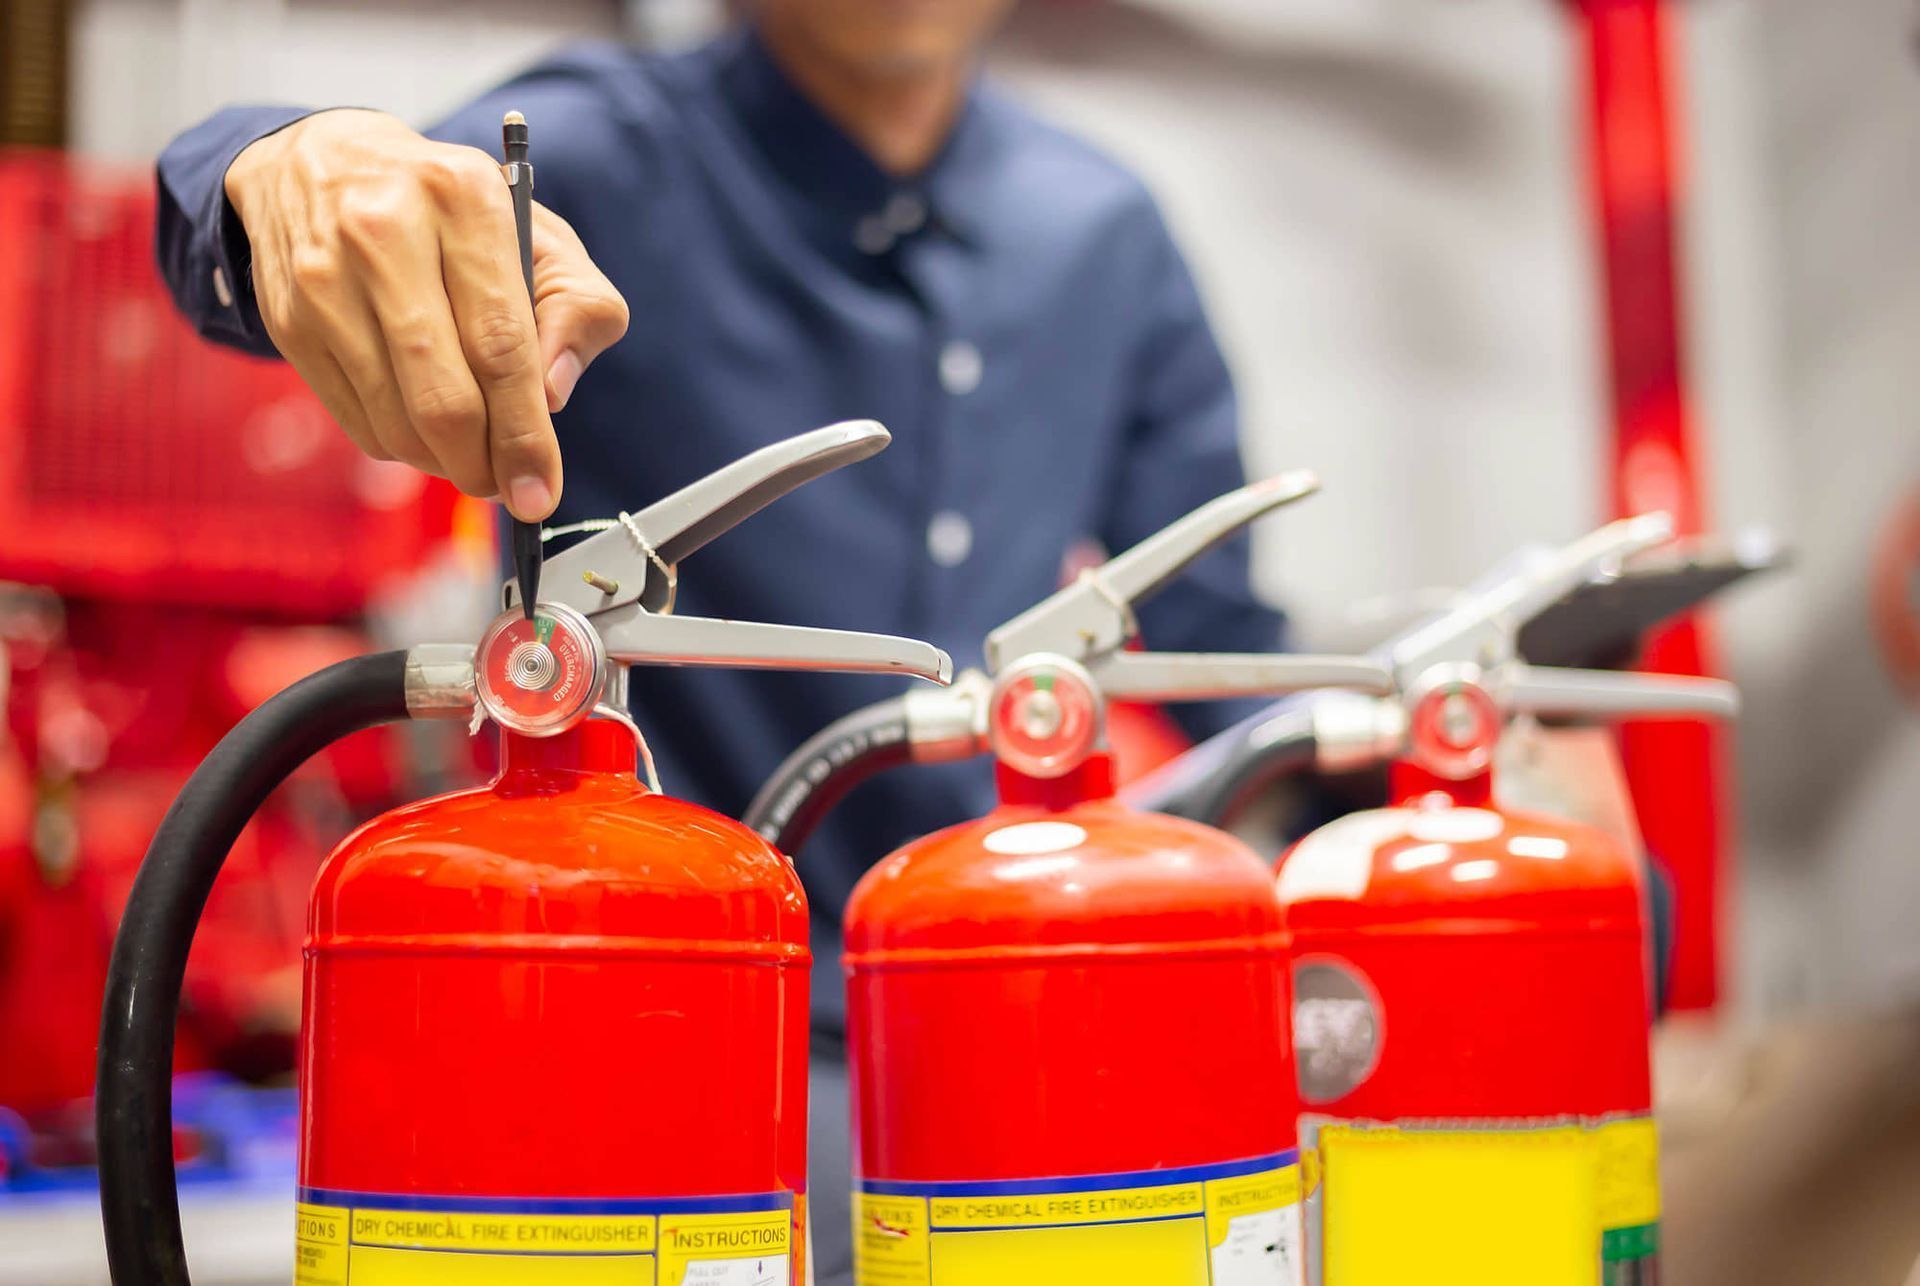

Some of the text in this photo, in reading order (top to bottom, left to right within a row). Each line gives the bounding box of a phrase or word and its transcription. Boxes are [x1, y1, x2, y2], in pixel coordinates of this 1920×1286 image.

[553, 644, 576, 702] OVERCHARGED
[935, 1190, 1196, 1219] DRY CHEMICAL FIRE EXTINGUISHER
[356, 1218, 648, 1242] DRY CHEMICAL FIRE EXTINGUISHER
[673, 1227, 786, 1248] INSTRUCTIONS
